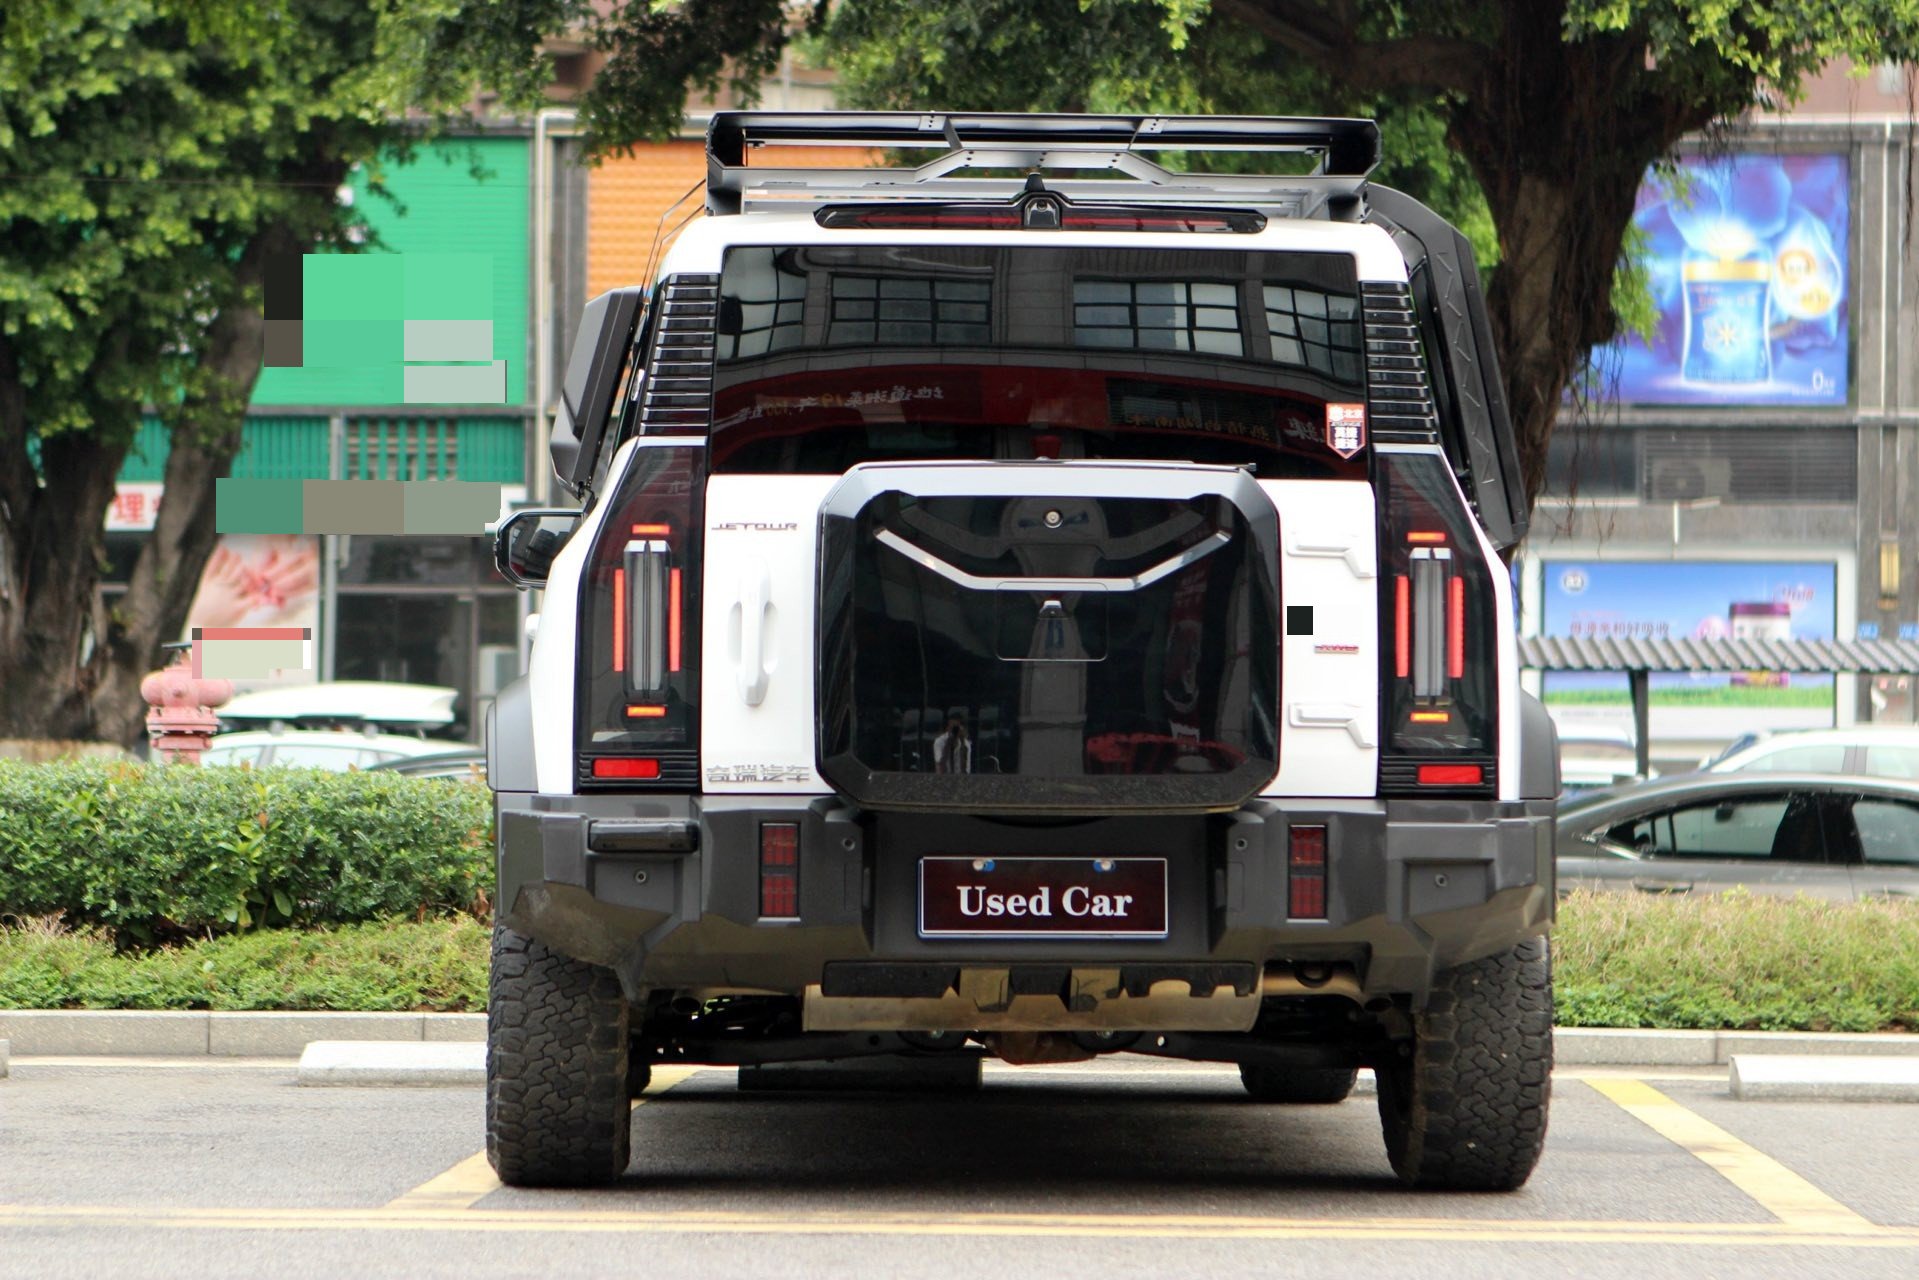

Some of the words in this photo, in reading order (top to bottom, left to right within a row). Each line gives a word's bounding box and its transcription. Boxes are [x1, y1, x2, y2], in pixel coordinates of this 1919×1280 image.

[711, 523, 798, 531] JETOUR
[706, 764, 810, 782] 奇瑞汽车
[956, 886, 1051, 916] Used
[1062, 886, 1133, 916] Car
